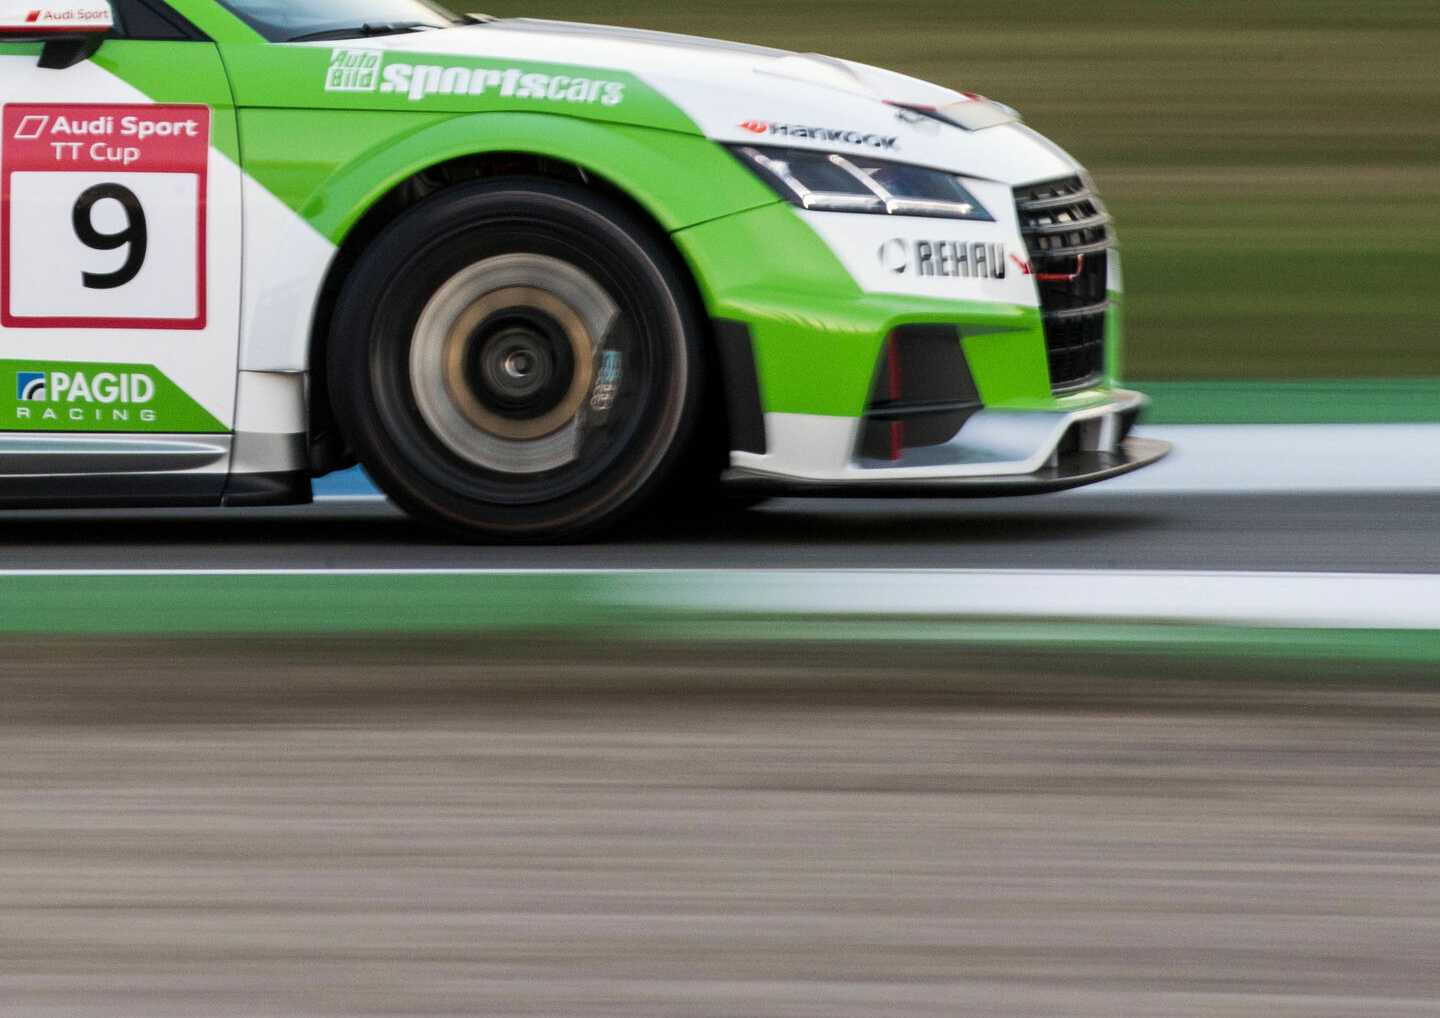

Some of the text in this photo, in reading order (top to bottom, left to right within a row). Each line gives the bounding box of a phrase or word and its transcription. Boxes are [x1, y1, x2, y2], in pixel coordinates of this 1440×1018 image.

[44, 9, 109, 20] Audi Sport
[332, 50, 378, 69] Auto
[380, 63, 627, 107] sportscars
[51, 116, 199, 140] Audi Sport
[50, 142, 141, 165] TT Cup
[72, 182, 148, 289] 9
[914, 240, 1006, 279] REHAU
[50, 372, 155, 403] PAGID
[16, 407, 157, 421] RACING
